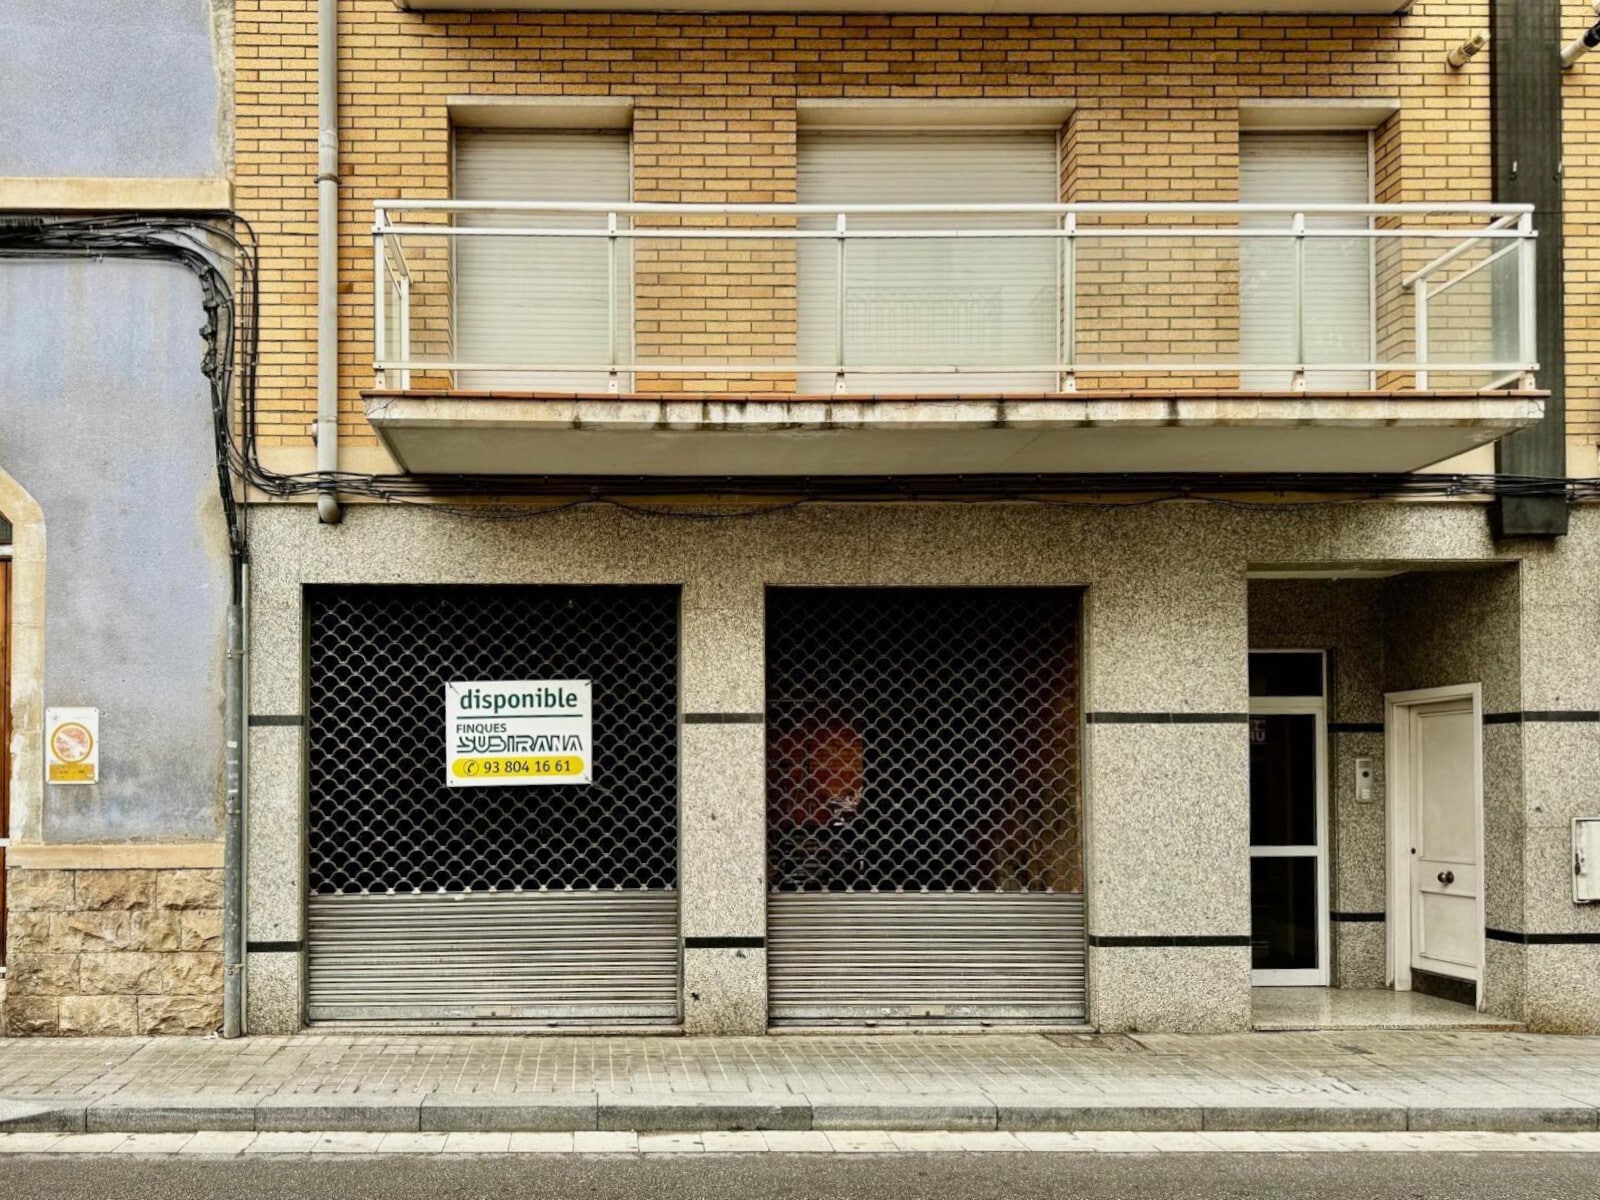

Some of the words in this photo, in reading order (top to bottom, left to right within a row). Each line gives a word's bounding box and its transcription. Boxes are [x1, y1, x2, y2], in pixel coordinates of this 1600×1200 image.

[460, 687, 578, 714] disponible
[456, 723, 507, 734] FINQUES
[456, 735, 583, 753] SUBIRANA
[483, 761, 500, 774] 93
[504, 761, 529, 773] 804
[535, 760, 550, 773] 16
[555, 760, 571, 772] 61
